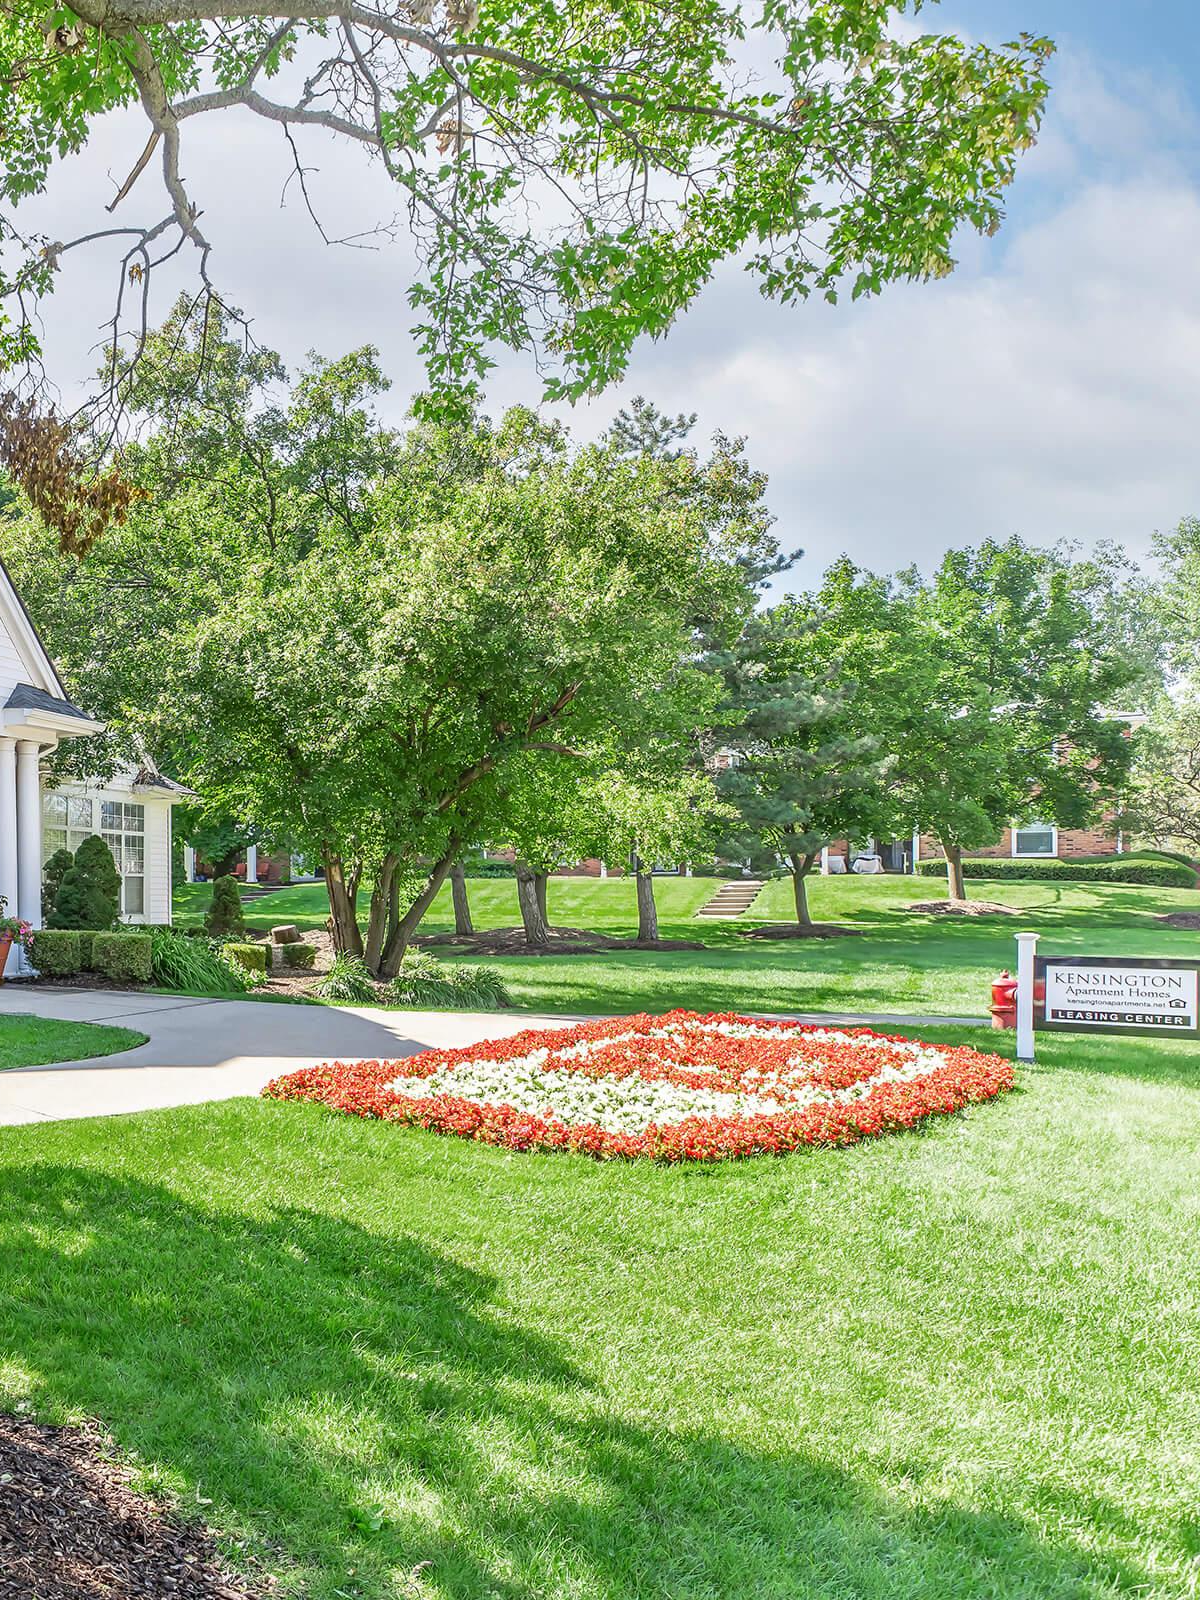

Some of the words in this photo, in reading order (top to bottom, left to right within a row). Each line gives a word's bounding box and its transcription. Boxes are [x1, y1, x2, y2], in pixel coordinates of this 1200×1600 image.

[1055, 972, 1182, 988] KENSINGTON
[1065, 985, 1124, 997] Apartment
[1129, 988, 1171, 999] Homes
[1067, 998, 1166, 1008] kensingtonapartments.net
[1058, 1010, 1119, 1021] LEASING
[1125, 1014, 1183, 1025] CENTER
